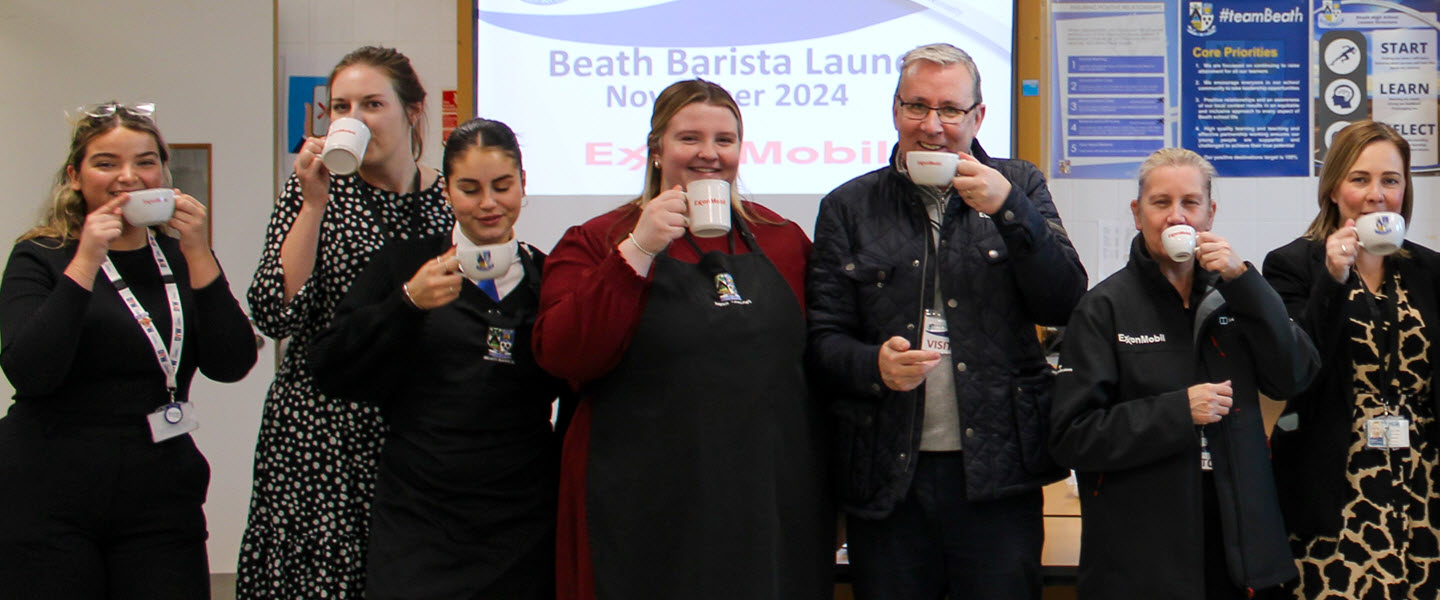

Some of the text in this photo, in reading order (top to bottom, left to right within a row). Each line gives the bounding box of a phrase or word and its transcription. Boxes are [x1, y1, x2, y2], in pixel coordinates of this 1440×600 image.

[1219, 6, 1304, 23] #teamBeath
[1192, 46, 1279, 58] Core Priorities
[1380, 42, 1429, 54] START
[549, 46, 906, 77] Beath Barista Laun
[1070, 82, 1077, 91] 2
[1380, 83, 1429, 95] LEARN
[775, 83, 849, 107] 2024
[1070, 102, 1077, 111] 3
[1070, 123, 1077, 132] 4
[1391, 124, 1436, 136] FLECT
[1070, 144, 1077, 153] 5
[585, 140, 888, 171] ExMobil
[927, 339, 951, 351] VISIT
[1117, 333, 1166, 345] ExxonMobil
